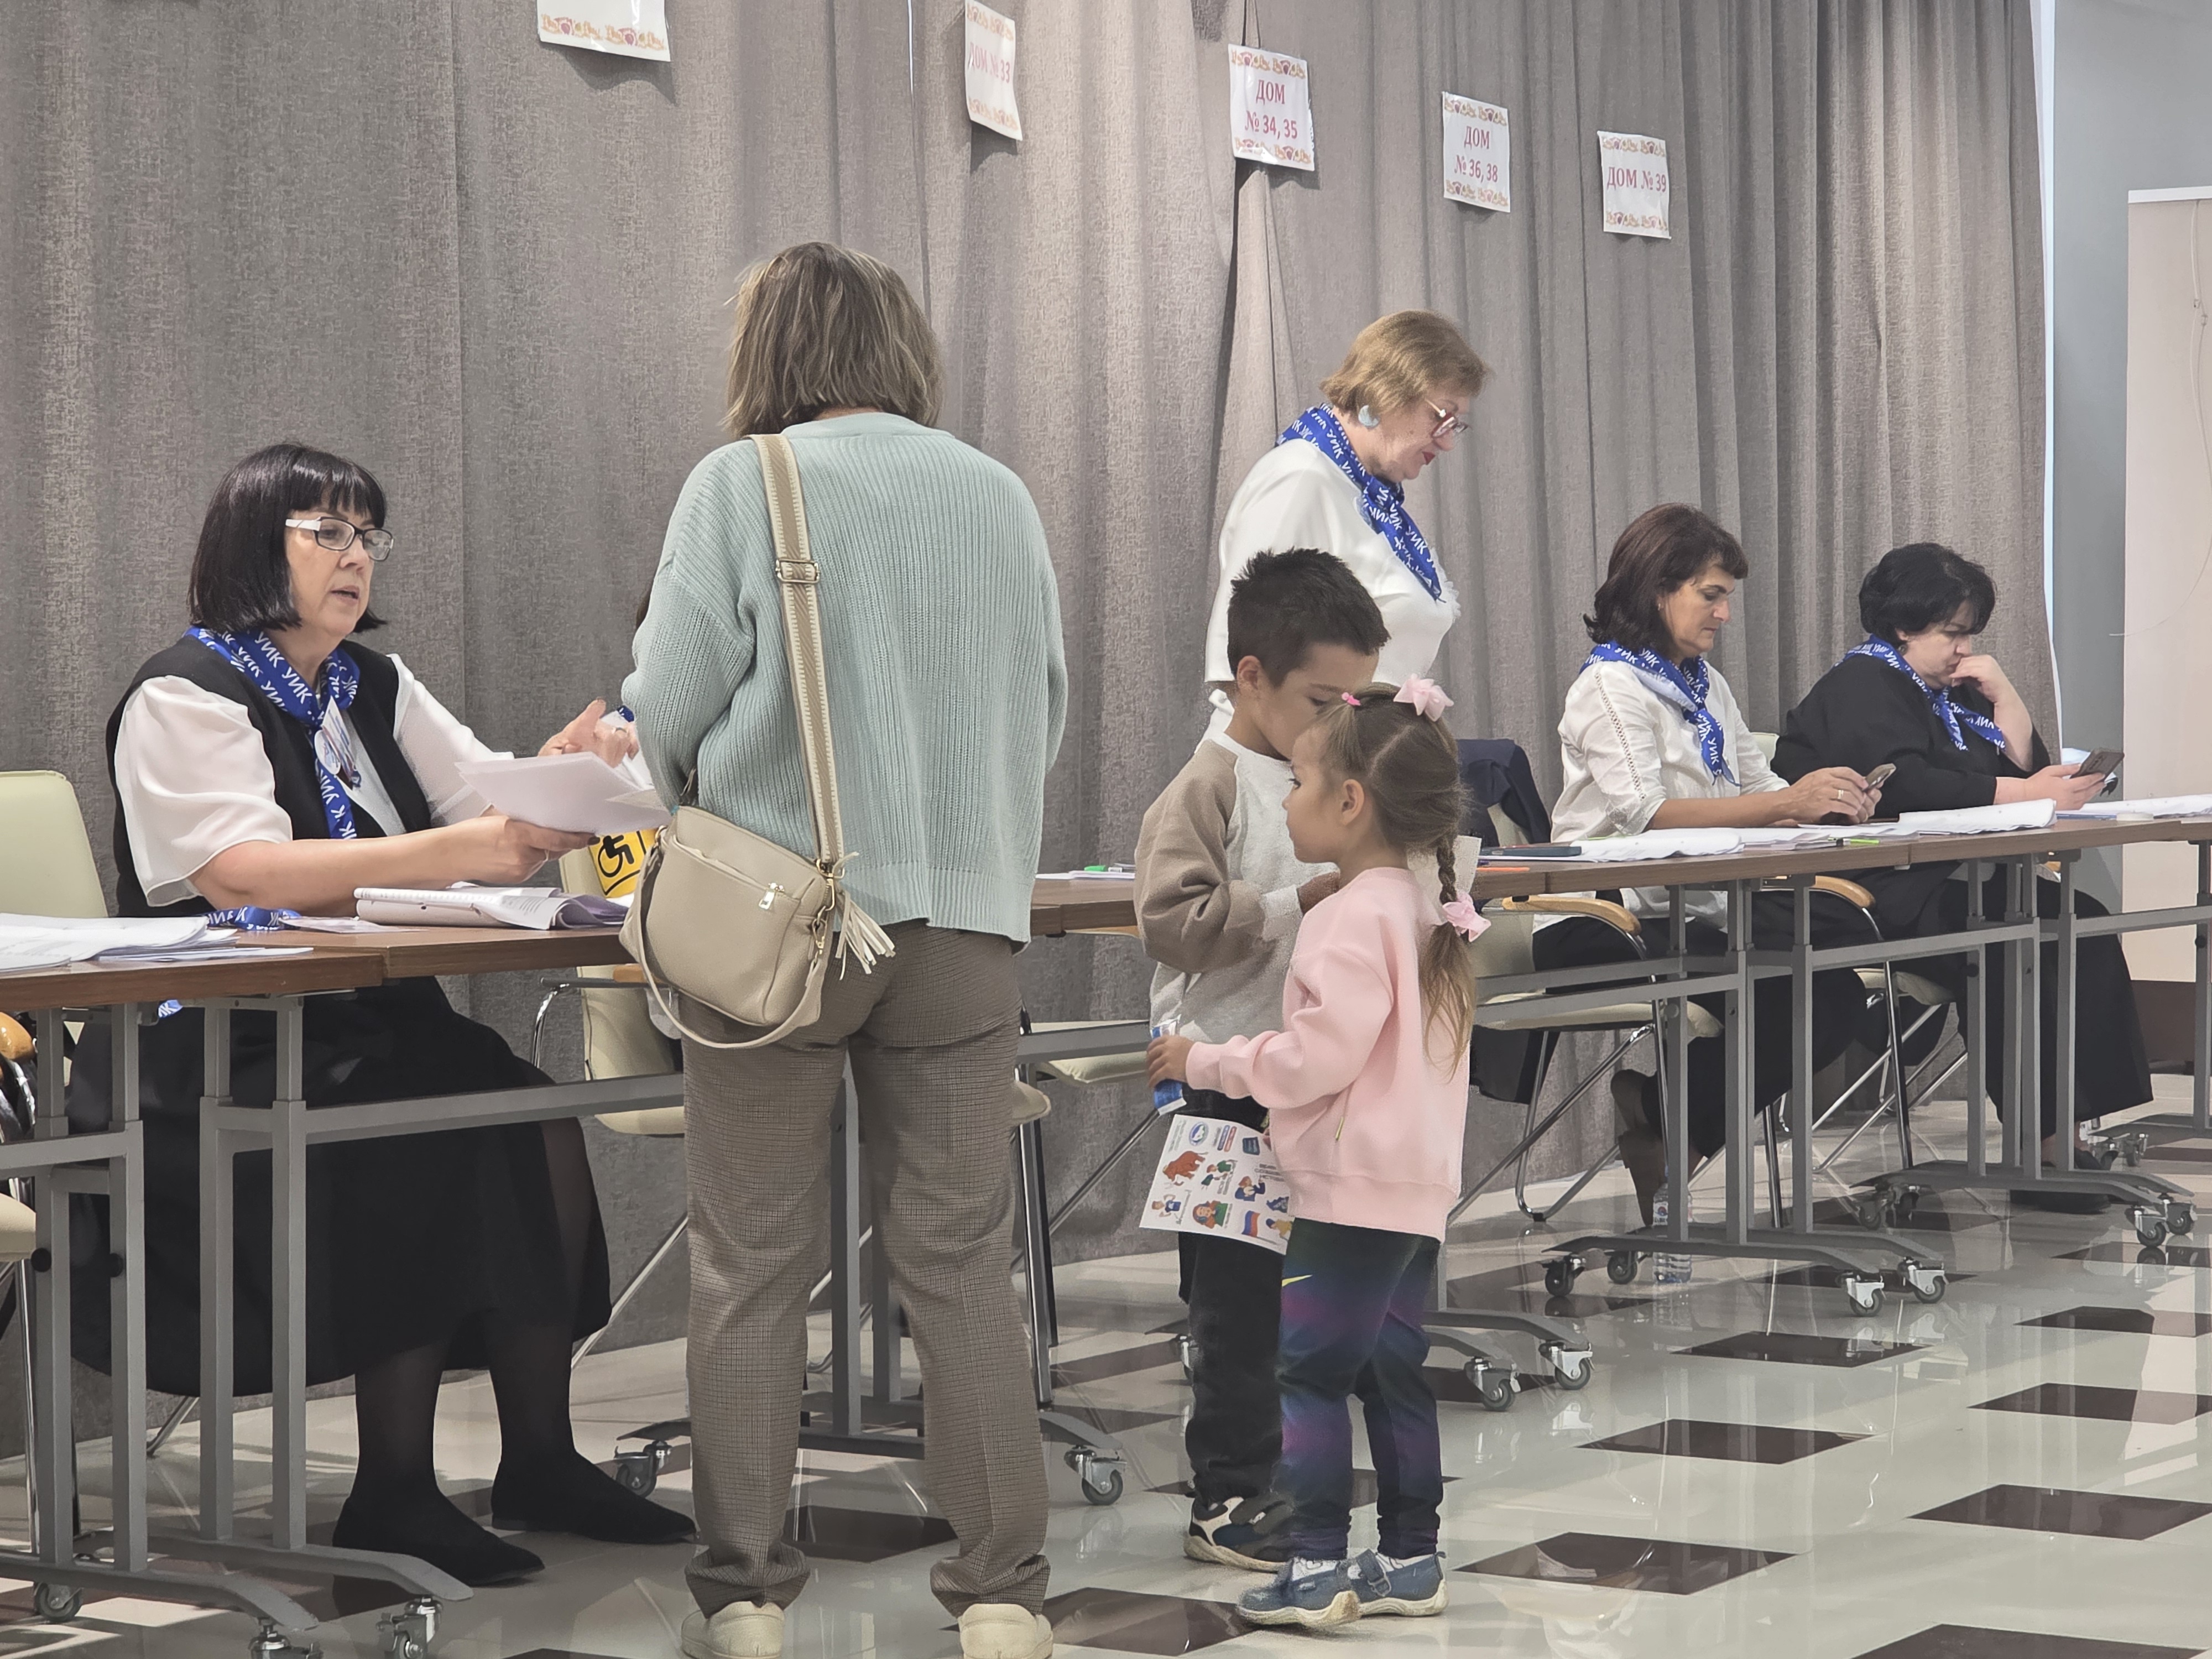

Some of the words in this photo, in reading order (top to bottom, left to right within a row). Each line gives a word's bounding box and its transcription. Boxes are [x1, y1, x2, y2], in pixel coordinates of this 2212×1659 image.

[968, 41, 988, 73] ДОМ
[999, 59, 1010, 84] 33
[1255, 79, 1285, 106] ДОМ
[1245, 110, 1259, 132] №
[1262, 114, 1280, 140] 34,
[1283, 118, 1297, 139] 35
[1463, 126, 1490, 150] ДОМ
[1454, 154, 1467, 175] №
[1469, 158, 1484, 184] 36,
[1486, 163, 1498, 182] 38
[1606, 166, 1637, 191] ДОМ
[1640, 170, 1653, 190] №
[1655, 173, 1667, 193] 39
[1326, 429, 1344, 460] УИК
[1405, 525, 1428, 555] УИК
[254, 631, 285, 669] УИК
[1639, 648, 1660, 668] УИК
[281, 666, 313, 705] УИК
[1707, 737, 1719, 765] УИК
